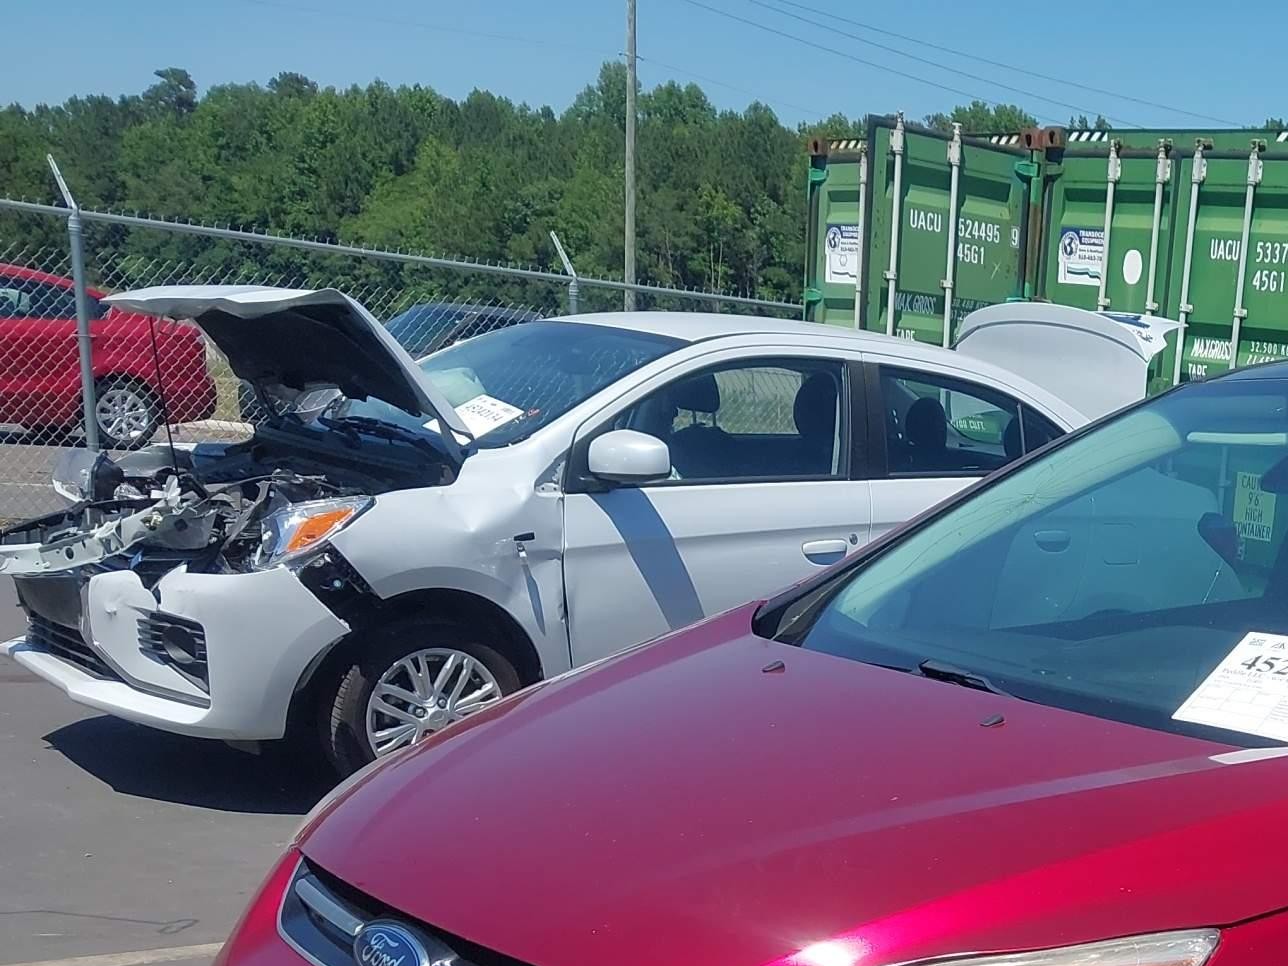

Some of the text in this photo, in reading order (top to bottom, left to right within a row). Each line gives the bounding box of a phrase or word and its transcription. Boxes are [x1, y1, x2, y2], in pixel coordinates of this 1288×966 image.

[910, 208, 1019, 246] UACU 524495 9
[957, 242, 985, 265] 45G1
[1210, 239, 1241, 261] UACU
[1252, 270, 1285, 293] 45G1
[1250, 341, 1278, 355] 32.500
